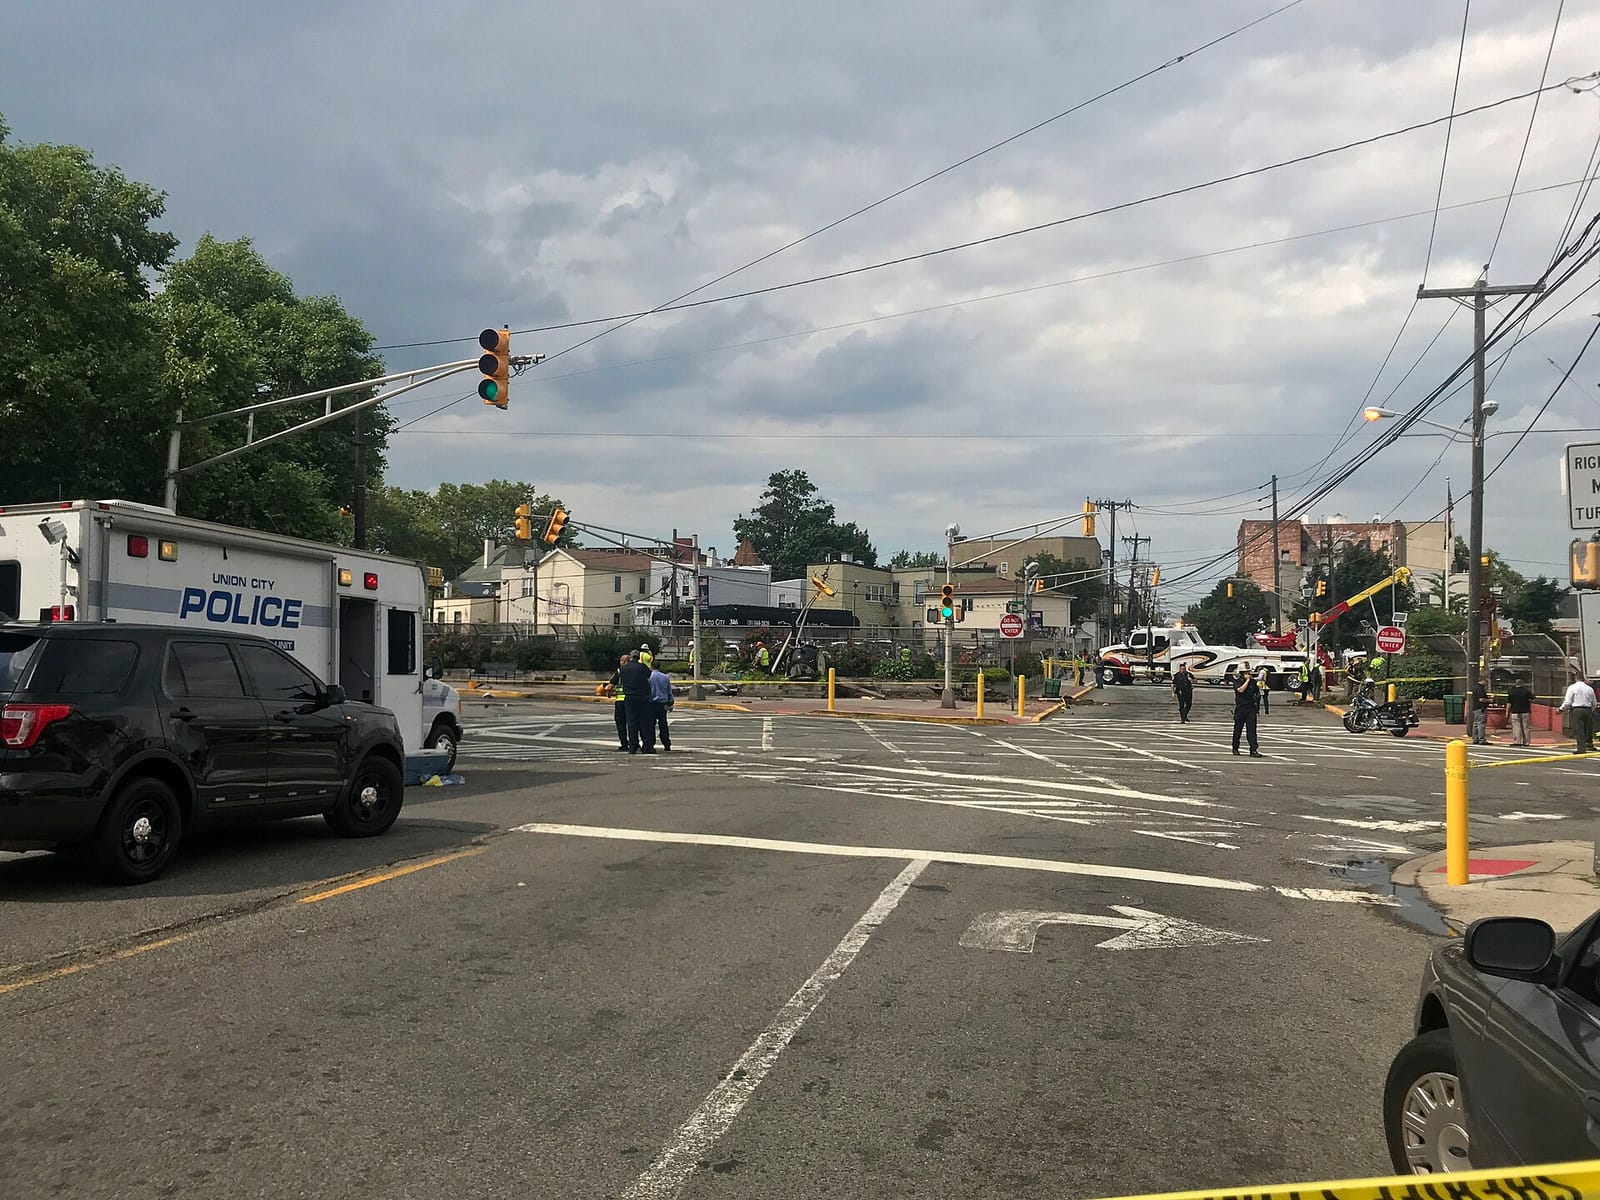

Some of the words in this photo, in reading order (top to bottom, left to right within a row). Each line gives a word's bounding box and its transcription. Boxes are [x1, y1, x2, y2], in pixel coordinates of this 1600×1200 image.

[212, 573, 247, 588] UNION
[251, 578, 276, 591] CITY
[179, 587, 303, 629] POLICE
